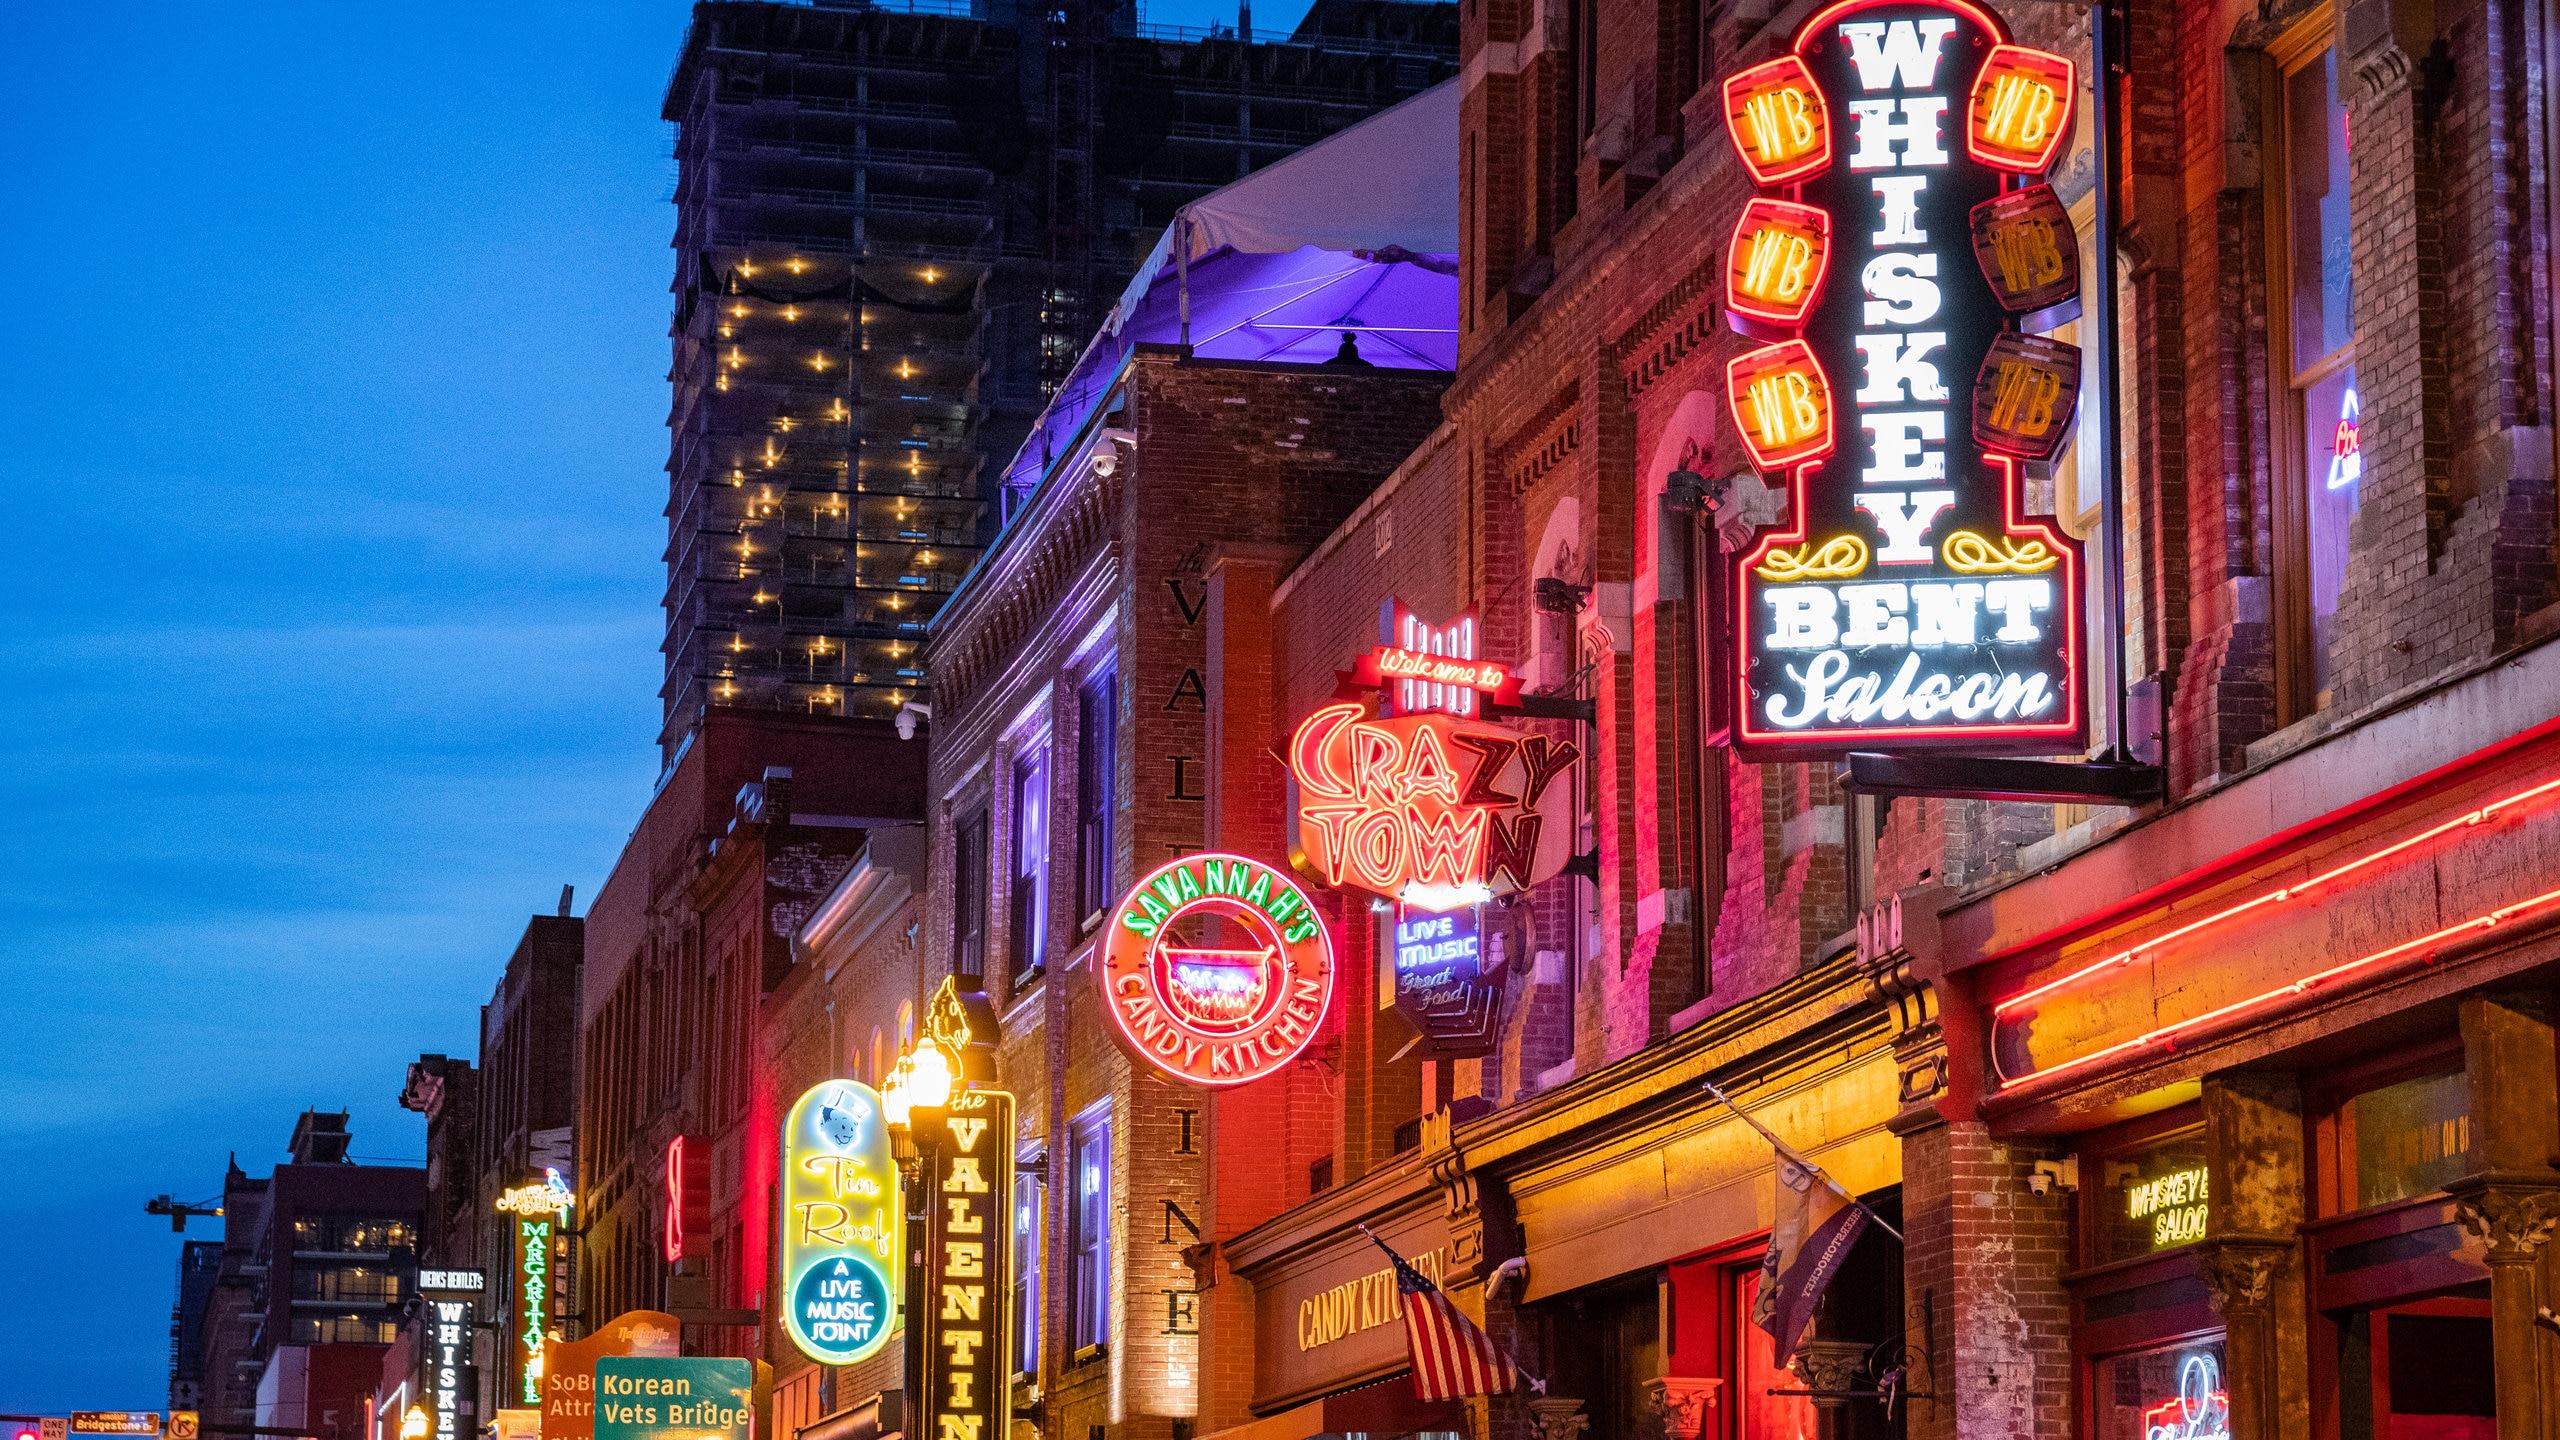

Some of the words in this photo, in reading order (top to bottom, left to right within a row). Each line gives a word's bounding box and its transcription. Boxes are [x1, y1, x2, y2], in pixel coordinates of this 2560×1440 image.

[1744, 87, 1814, 161] WB
[1984, 73, 2054, 147] WB
[1744, 228, 1813, 301] WB
[1992, 217, 2063, 292] WB
[1838, 17, 1957, 567] WHISKEY
[1746, 370, 1819, 446] WB
[1990, 361, 2060, 436] WB
[1763, 578, 2051, 650] BENT
[1379, 646, 1476, 685] Welcome
[1475, 665, 1504, 690] to
[1765, 649, 2053, 727] Saloon
[1289, 703, 1581, 811] CRAZY
[1300, 802, 1543, 893] TOWN
[1121, 859, 1321, 944] SAVANNAH'S
[1398, 916, 1454, 945] LIVE
[1398, 935, 1479, 968] MUSIC
[1398, 966, 1455, 995] Great
[1416, 980, 1464, 1012] Food
[1115, 972, 1203, 1069] CANDY
[1210, 977, 1322, 1074] KITCHEN
[950, 1088, 987, 1111] the
[804, 1154, 880, 1198] Tin
[2130, 1169, 2200, 1219] WHISKEY
[793, 1202, 891, 1257] Roof
[820, 1279, 862, 1299] LIVE
[833, 1258, 849, 1277] A
[807, 1300, 876, 1321] MUSIC
[810, 1322, 872, 1342] JOINT
[1298, 1279, 1360, 1352] CANDY
[603, 1374, 691, 1396] Korean
[44, 1420, 64, 1429] ONE
[76, 1419, 141, 1432] Bridgestone
[550, 1399, 596, 1417] Attr
[604, 1403, 657, 1425] Vets
[669, 1402, 750, 1431] Bridge
[44, 1430, 64, 1440] WAY
